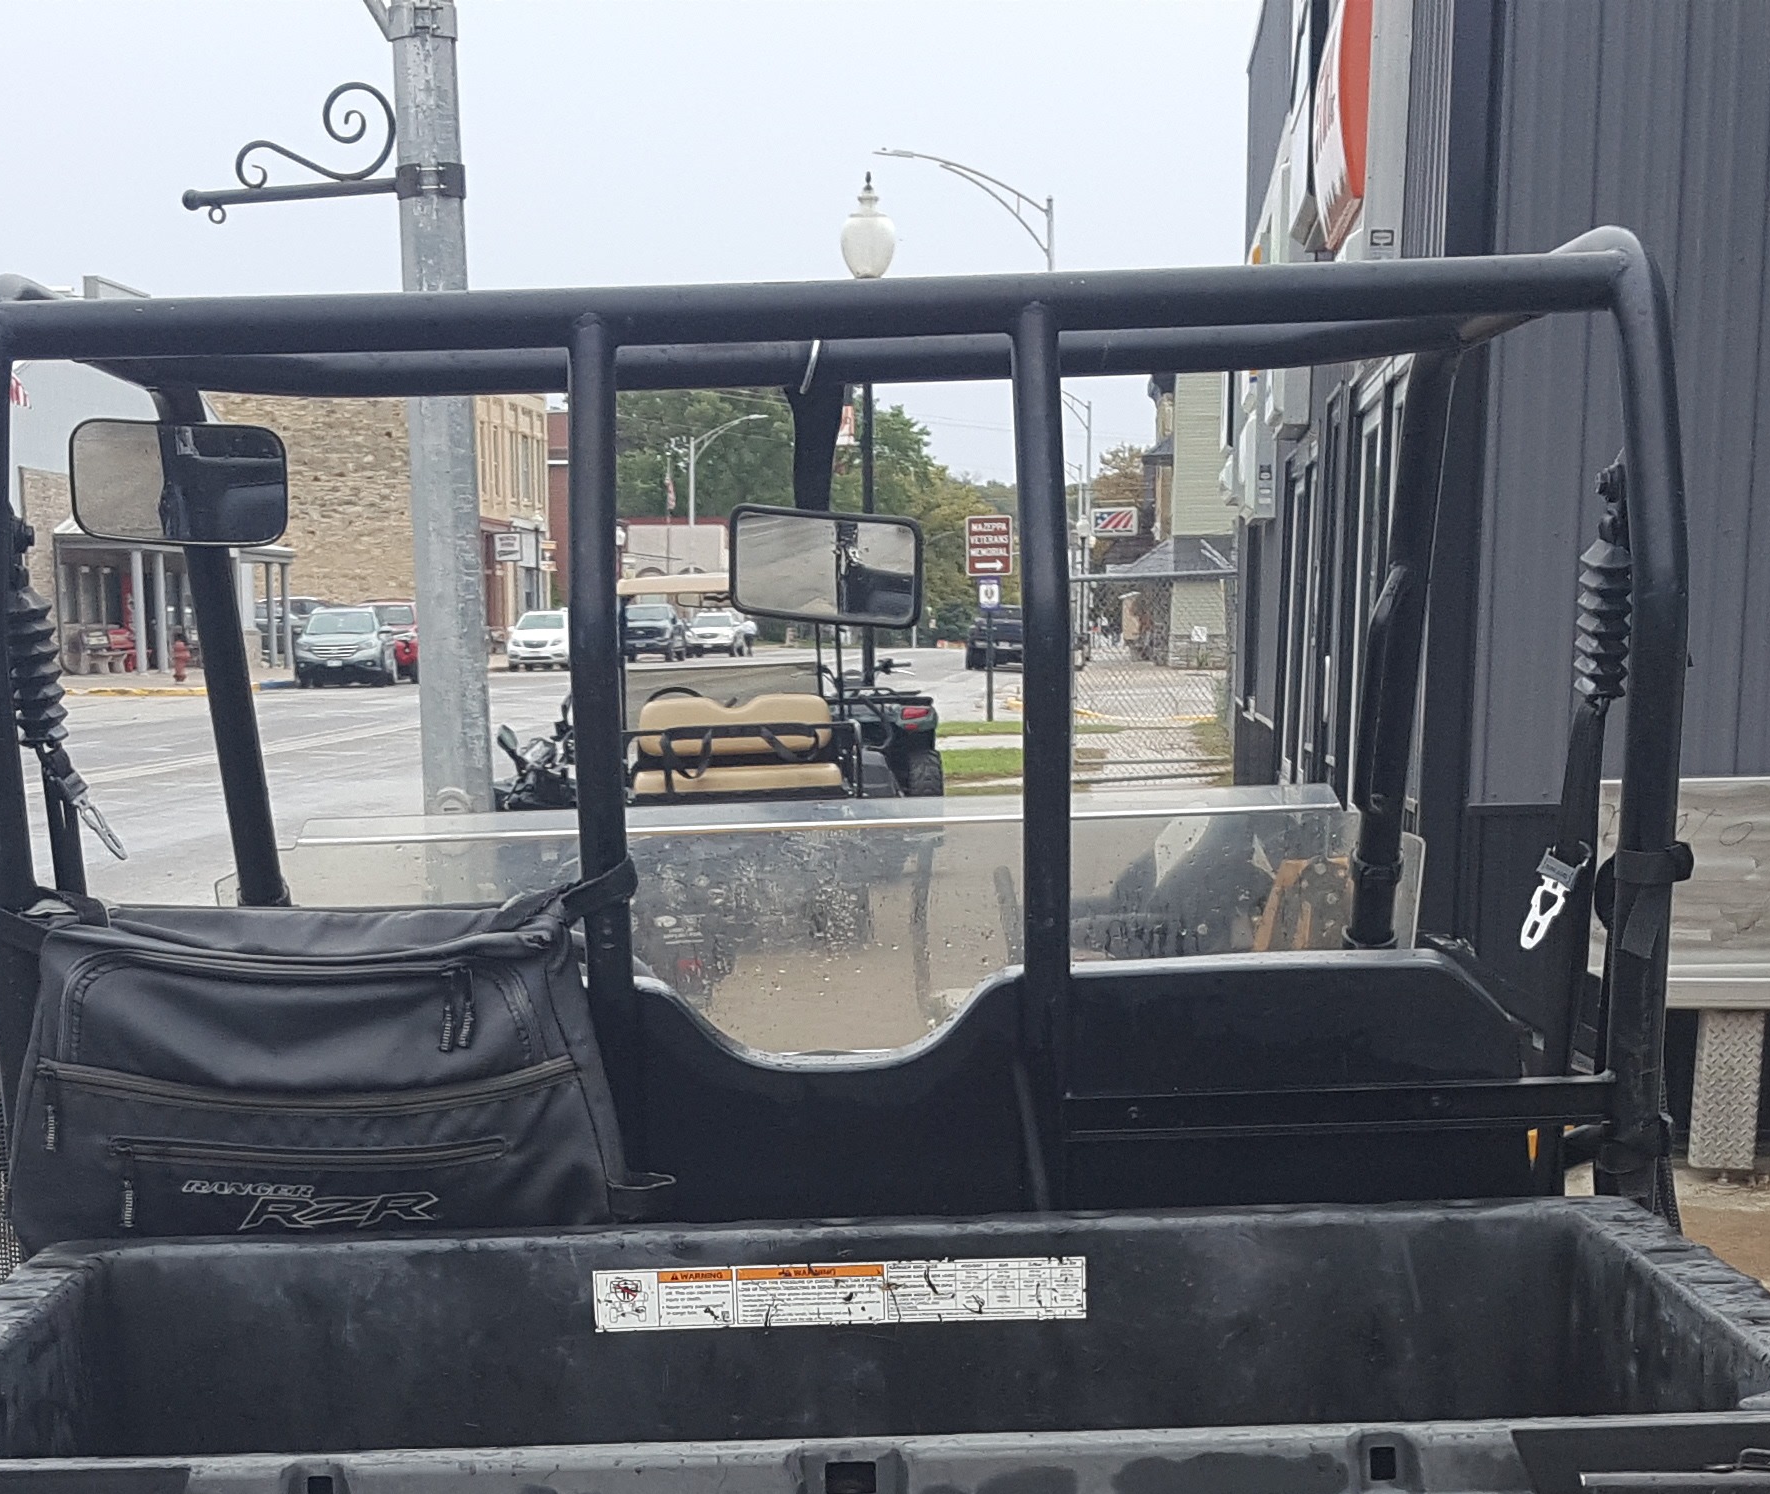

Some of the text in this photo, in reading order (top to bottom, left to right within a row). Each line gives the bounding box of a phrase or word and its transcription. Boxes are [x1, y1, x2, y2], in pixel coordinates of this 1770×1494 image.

[971, 522, 1007, 532] MAZEPPA
[970, 535, 1009, 545] VETERANS
[970, 547, 1009, 557] MEMORIAL
[182, 1180, 315, 1198] RANGER
[238, 1192, 438, 1231] RZR
[680, 1272, 723, 1280] WARNING
